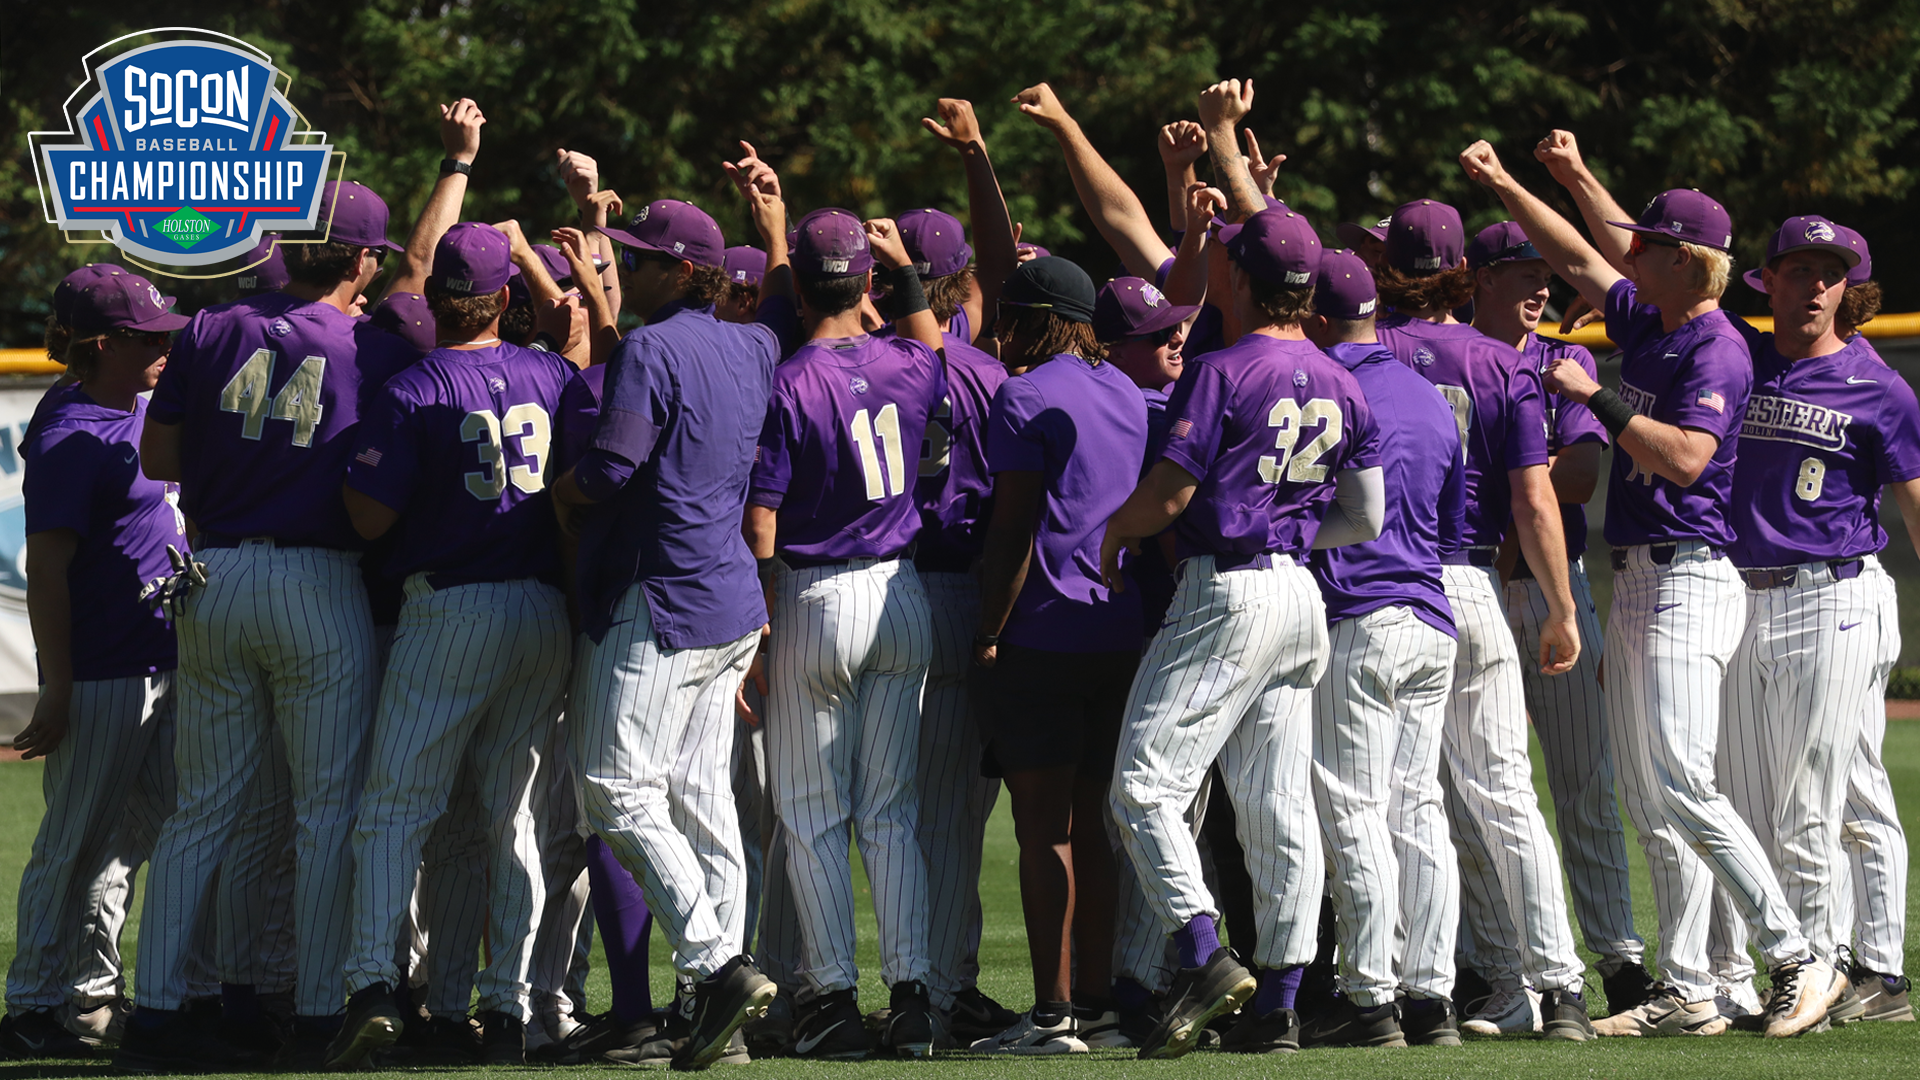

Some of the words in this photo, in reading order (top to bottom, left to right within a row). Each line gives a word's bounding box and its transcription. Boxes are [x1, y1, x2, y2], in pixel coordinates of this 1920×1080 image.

[822, 260, 849, 273] WCU
[1284, 270, 1311, 284] WCU
[1414, 256, 1441, 270] WCU
[238, 277, 257, 289] WCU
[446, 277, 473, 292] WCU
[1358, 298, 1376, 315] WCU
[220, 348, 326, 448] 44
[1743, 395, 1851, 440] ESTERN
[460, 402, 553, 500] 33
[850, 403, 905, 500] 11
[1257, 397, 1343, 484] 32
[1794, 456, 1826, 501] 8
